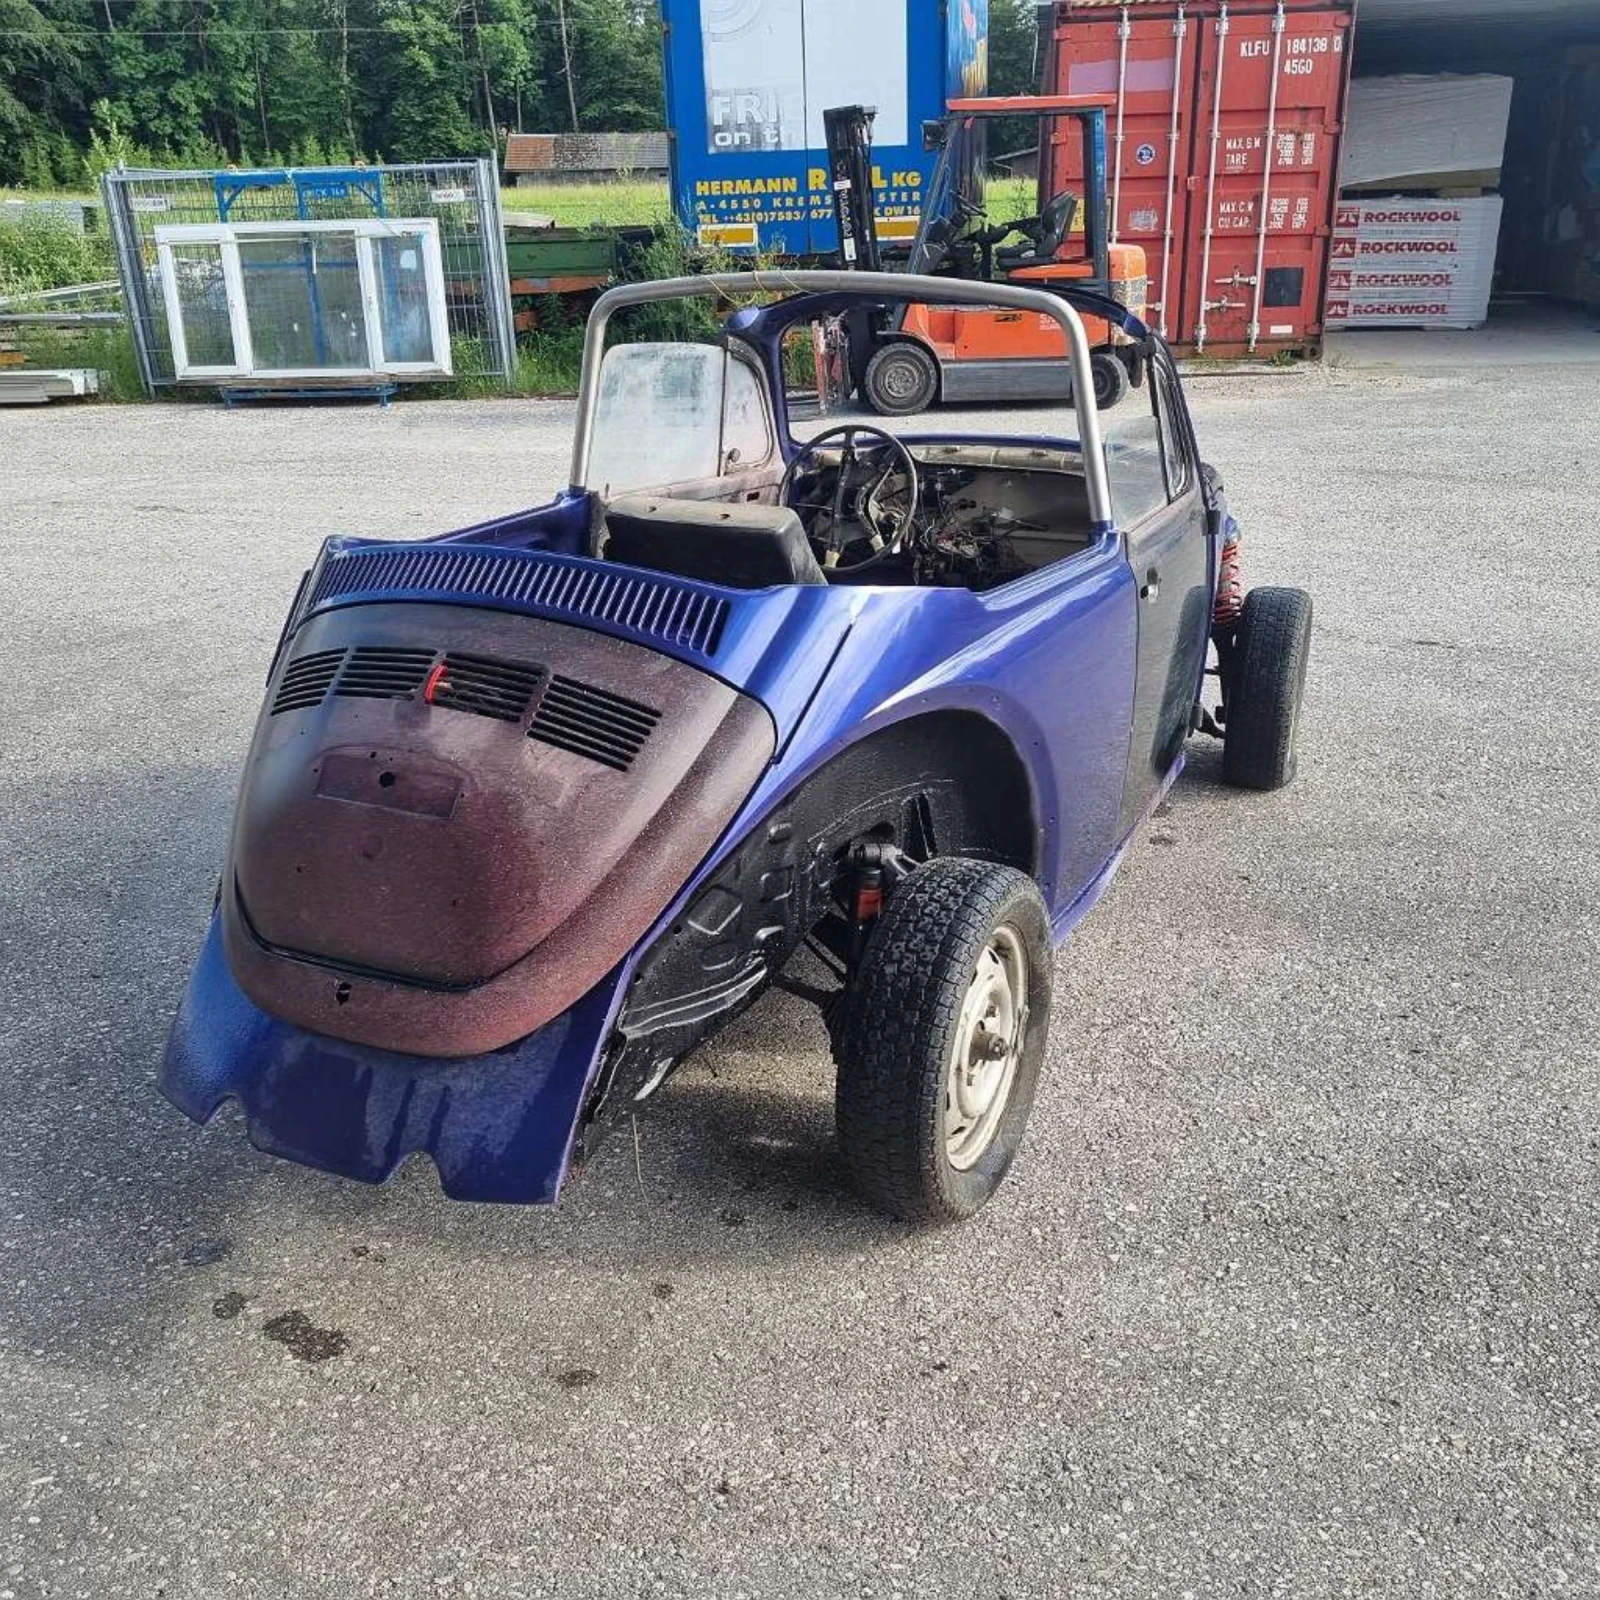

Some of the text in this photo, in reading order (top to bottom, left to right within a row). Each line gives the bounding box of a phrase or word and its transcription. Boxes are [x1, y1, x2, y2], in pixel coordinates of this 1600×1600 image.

[1240, 40, 1270, 57] KLFU
[1287, 38, 1327, 54] 184138
[715, 132, 751, 146] on
[1225, 153, 1248, 165] TARE
[696, 177, 797, 197] HERMANN
[892, 171, 921, 187] KG
[1364, 210, 1461, 223] ROCKWOOL
[1359, 241, 1458, 254] ROCKWOOL
[1356, 273, 1453, 288] ROCKWOOL
[1352, 303, 1449, 315] ROCKWOOL
